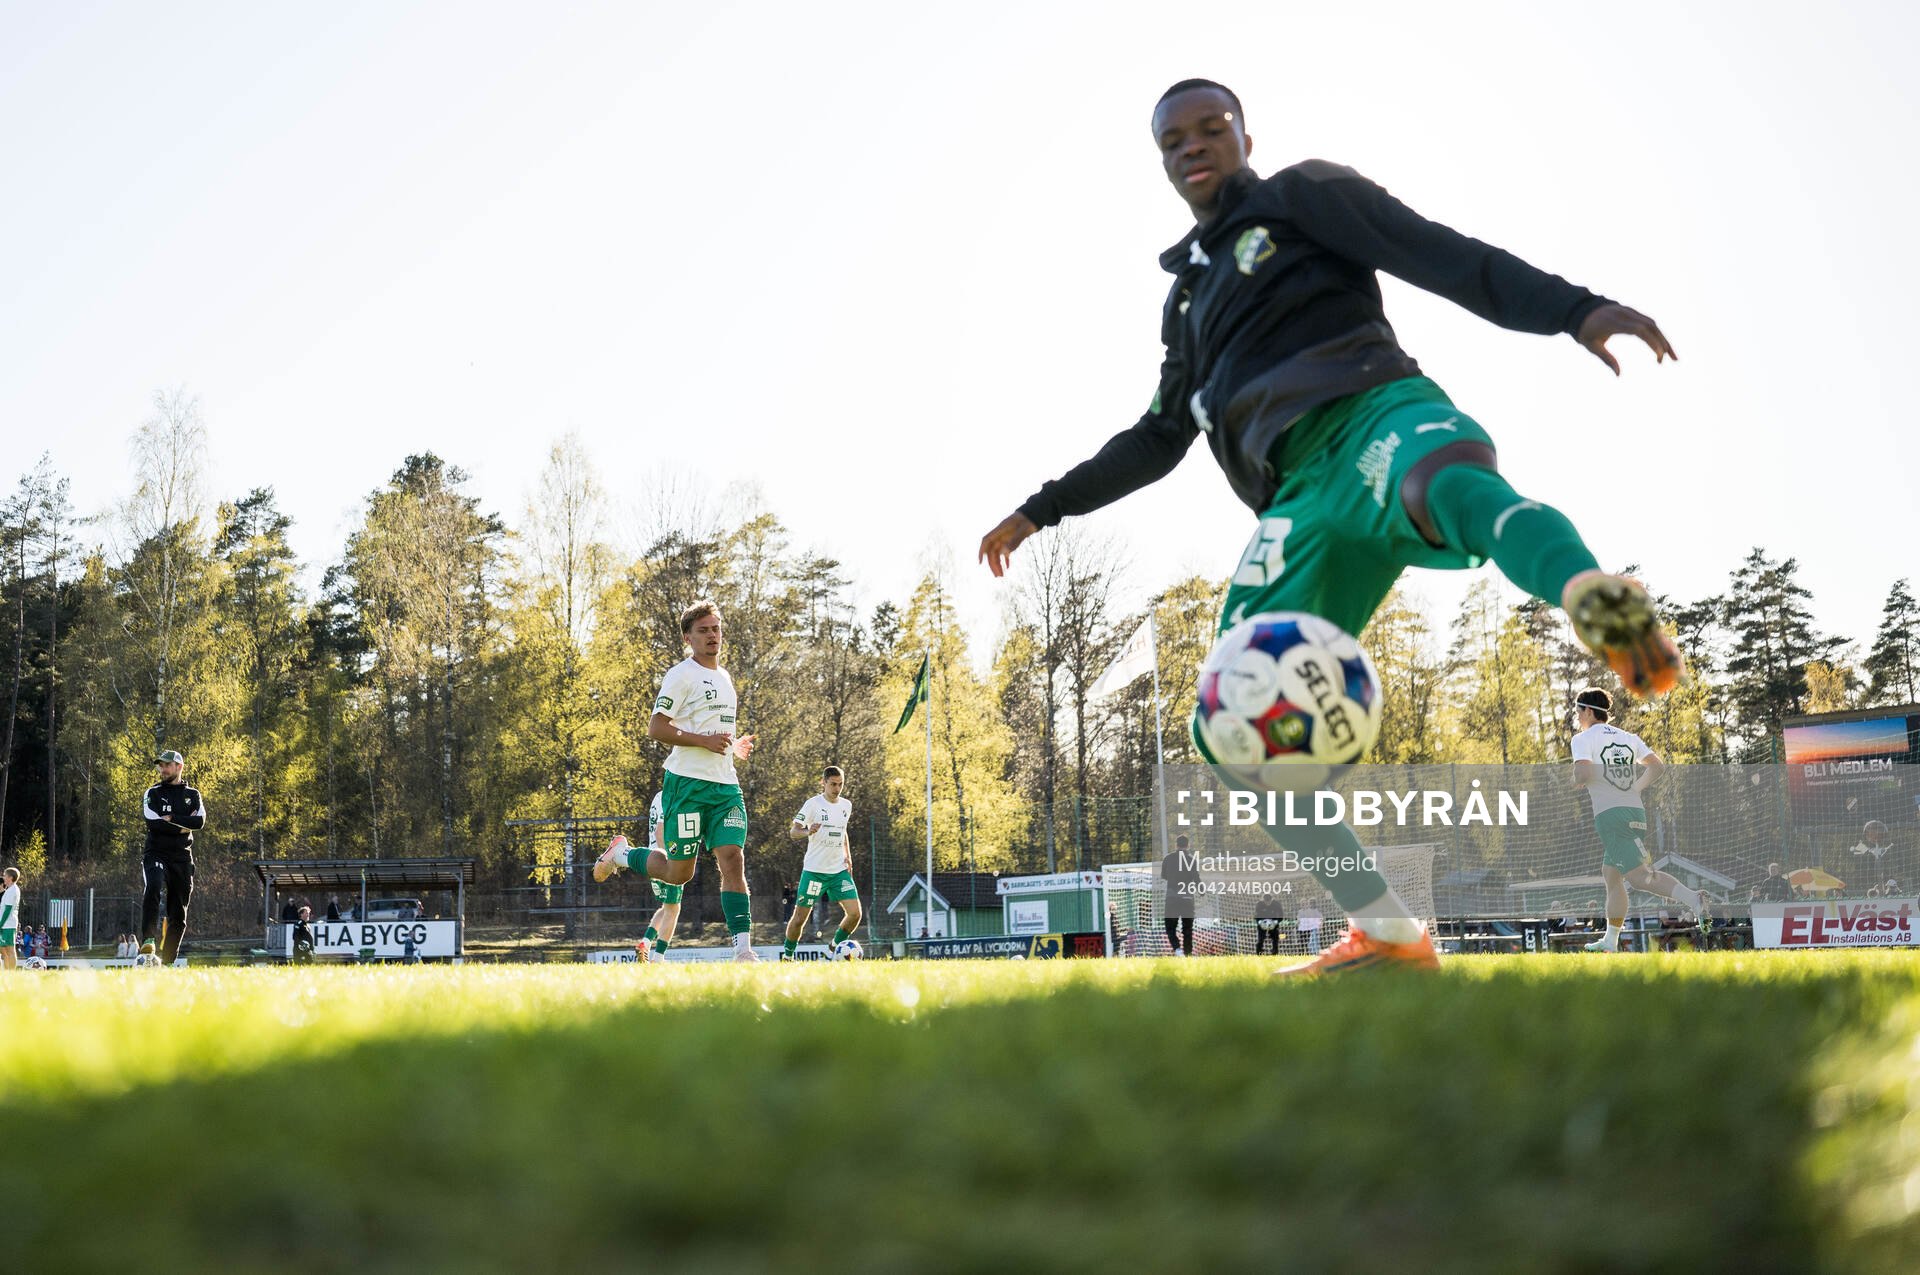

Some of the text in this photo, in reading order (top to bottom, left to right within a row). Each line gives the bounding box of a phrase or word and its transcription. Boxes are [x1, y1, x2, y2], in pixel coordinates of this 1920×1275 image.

[705, 689, 717, 700] 27
[1295, 659, 1356, 750] SELECT
[1607, 757, 1629, 767] LSK
[1804, 757, 1893, 778] BLI MEDLEM
[1609, 767, 1631, 779] 100
[683, 842, 698, 855] 27
[314, 924, 427, 946] H.A BYGG
[1525, 928, 1536, 953] ECT
[1830, 932, 1912, 944] Installations AB
[928, 946, 943, 956] PAY
[944, 945, 950, 955] &
[952, 944, 972, 955] PLAY
